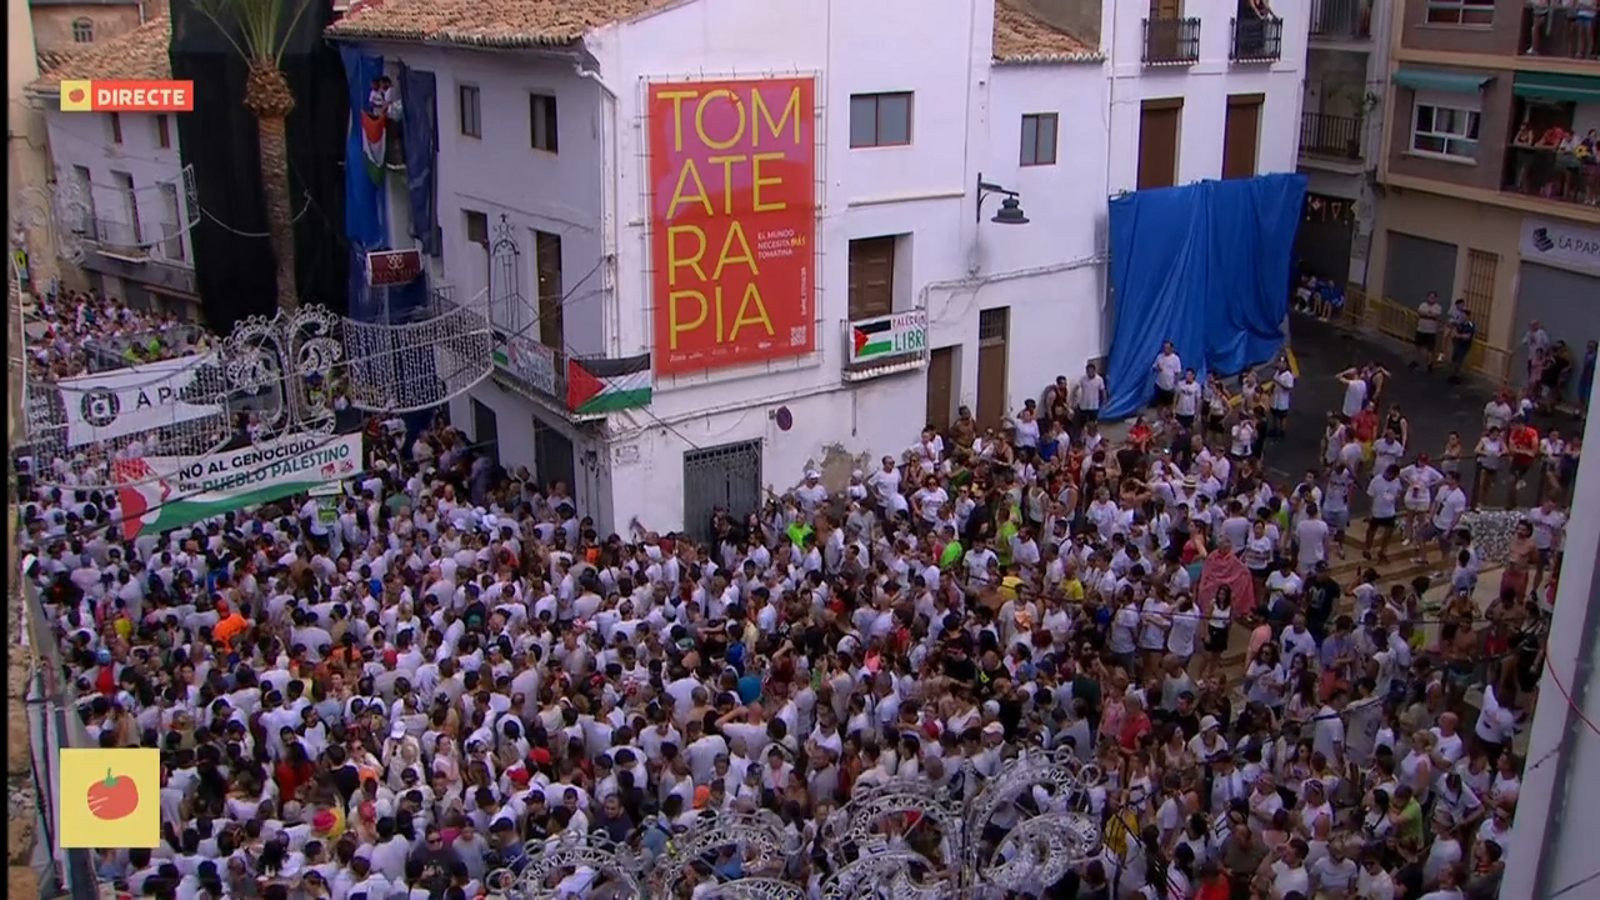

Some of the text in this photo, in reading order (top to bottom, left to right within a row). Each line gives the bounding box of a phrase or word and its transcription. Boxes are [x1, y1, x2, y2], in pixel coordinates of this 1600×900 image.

[656, 86, 800, 151] TOM
[666, 152, 786, 220] ATE
[667, 220, 760, 286] RA
[1558, 235, 1600, 256] LA PAP
[669, 282, 776, 350] PIA
[136, 387, 152, 410] À
[179, 439, 316, 481] NO AL GENOCIDIO
[179, 482, 200, 493] DEL
[202, 468, 267, 491] PUEBLO
[271, 444, 349, 478] PALESTINO
